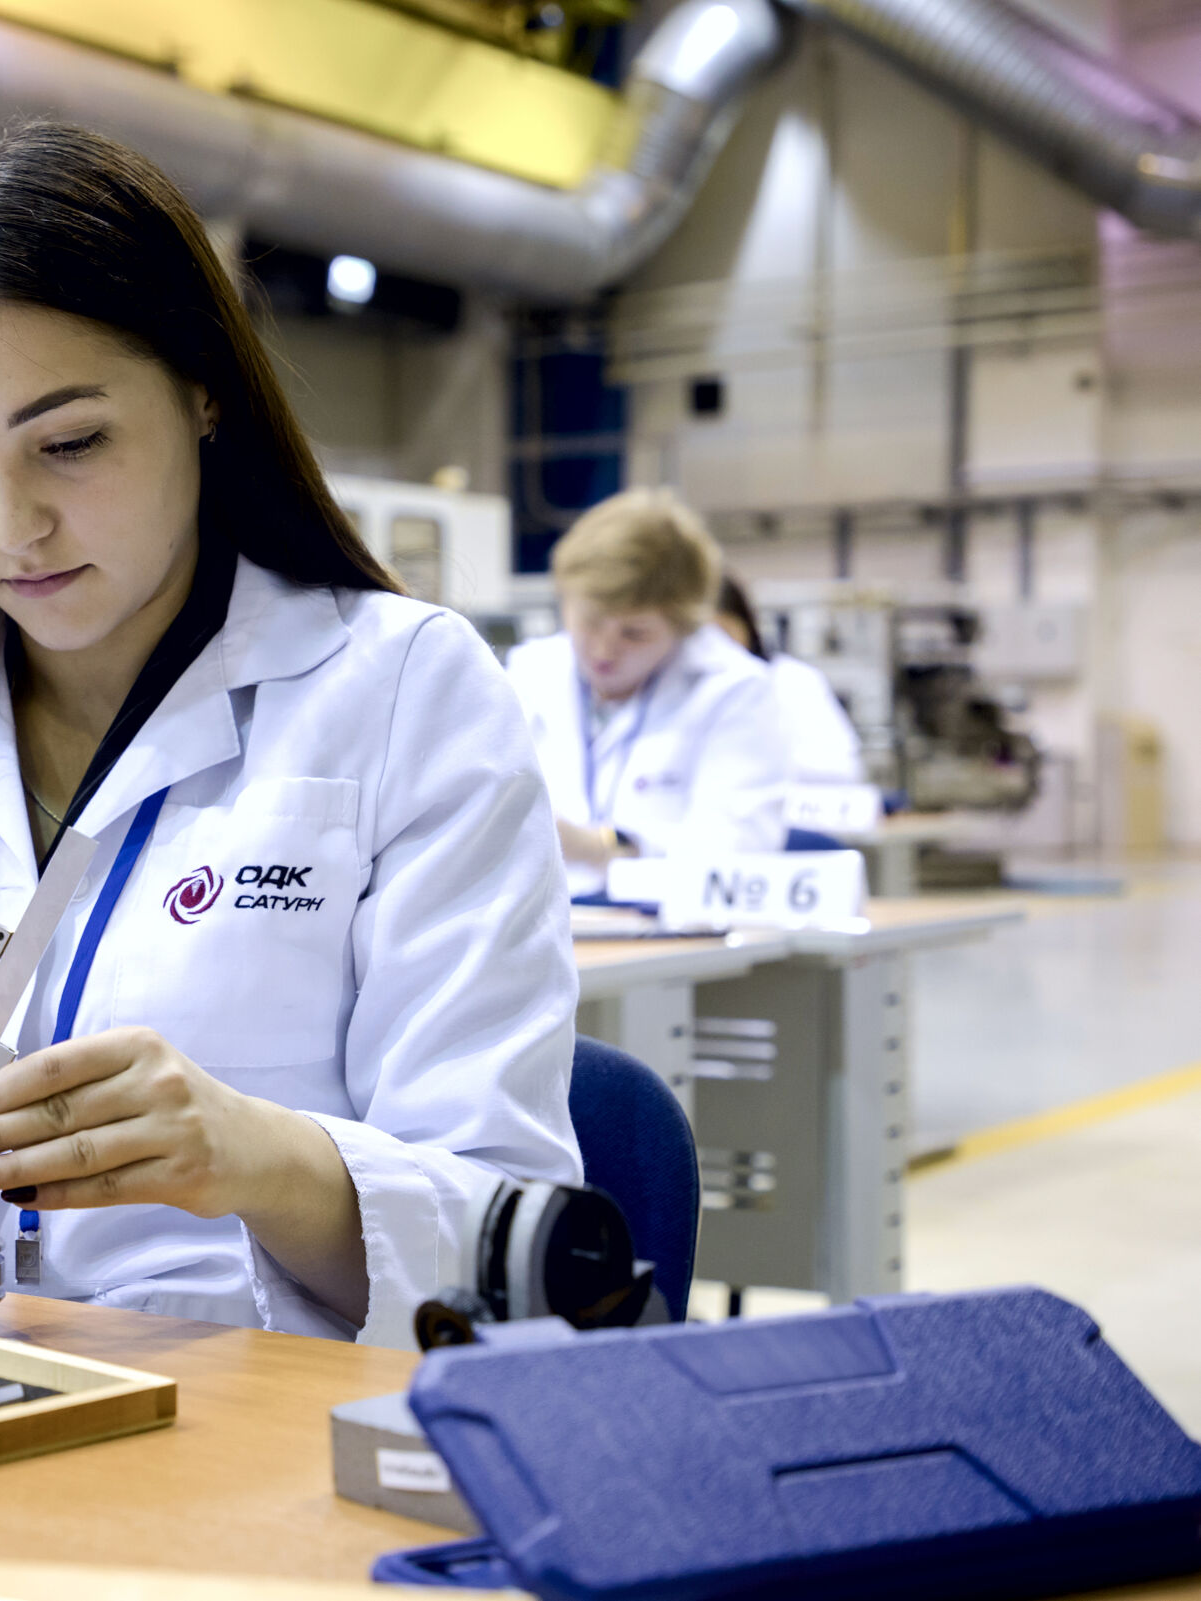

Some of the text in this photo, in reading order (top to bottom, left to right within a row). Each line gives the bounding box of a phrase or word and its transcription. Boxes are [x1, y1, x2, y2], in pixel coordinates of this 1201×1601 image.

[235, 865, 313, 889] ОДК
[234, 895, 326, 911] САТУРН
[788, 868, 819, 914] 6
